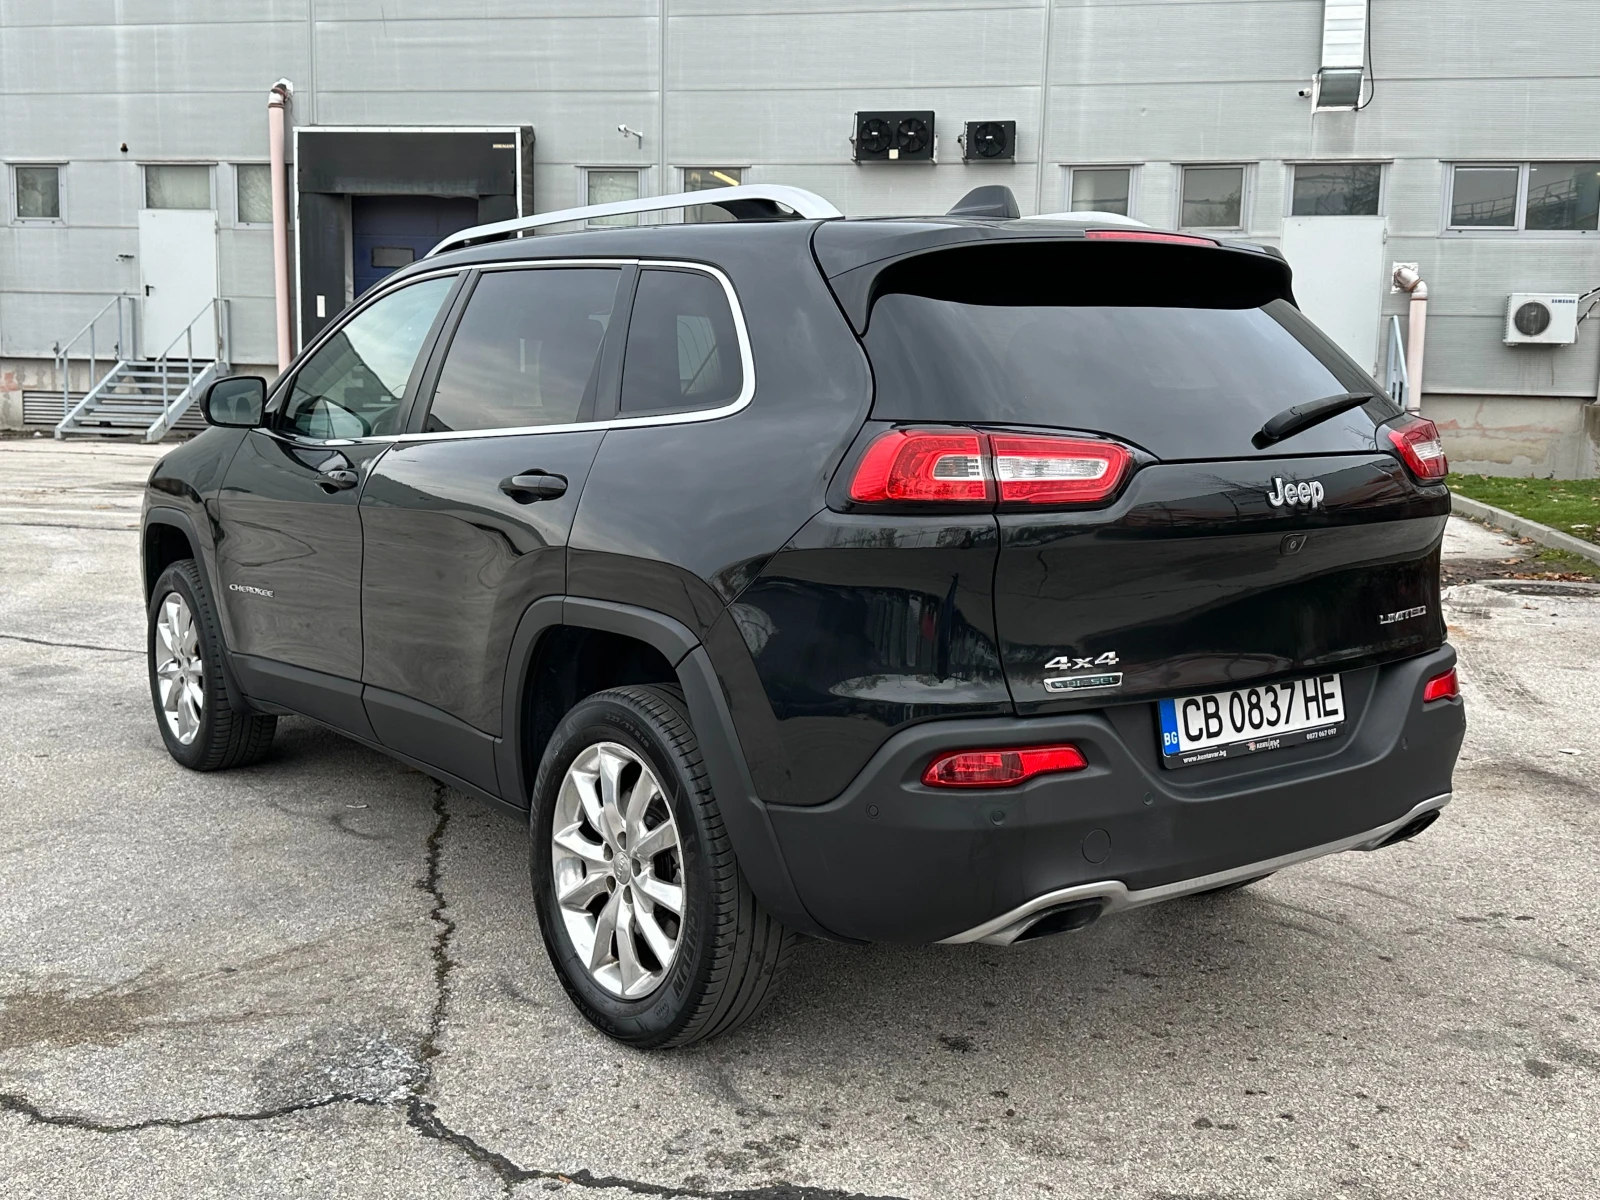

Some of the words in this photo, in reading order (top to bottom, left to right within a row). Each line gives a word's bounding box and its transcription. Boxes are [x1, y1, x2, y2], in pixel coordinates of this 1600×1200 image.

[1267, 477, 1325, 509] Jeep
[229, 583, 274, 598] CHEROKEE
[1379, 604, 1427, 625] LIMITED
[1044, 650, 1120, 671] 4x4
[1182, 695, 1223, 742] CB
[1228, 681, 1296, 733] 0837
[1301, 674, 1339, 721] HE
[1164, 732, 1178, 746] BG
